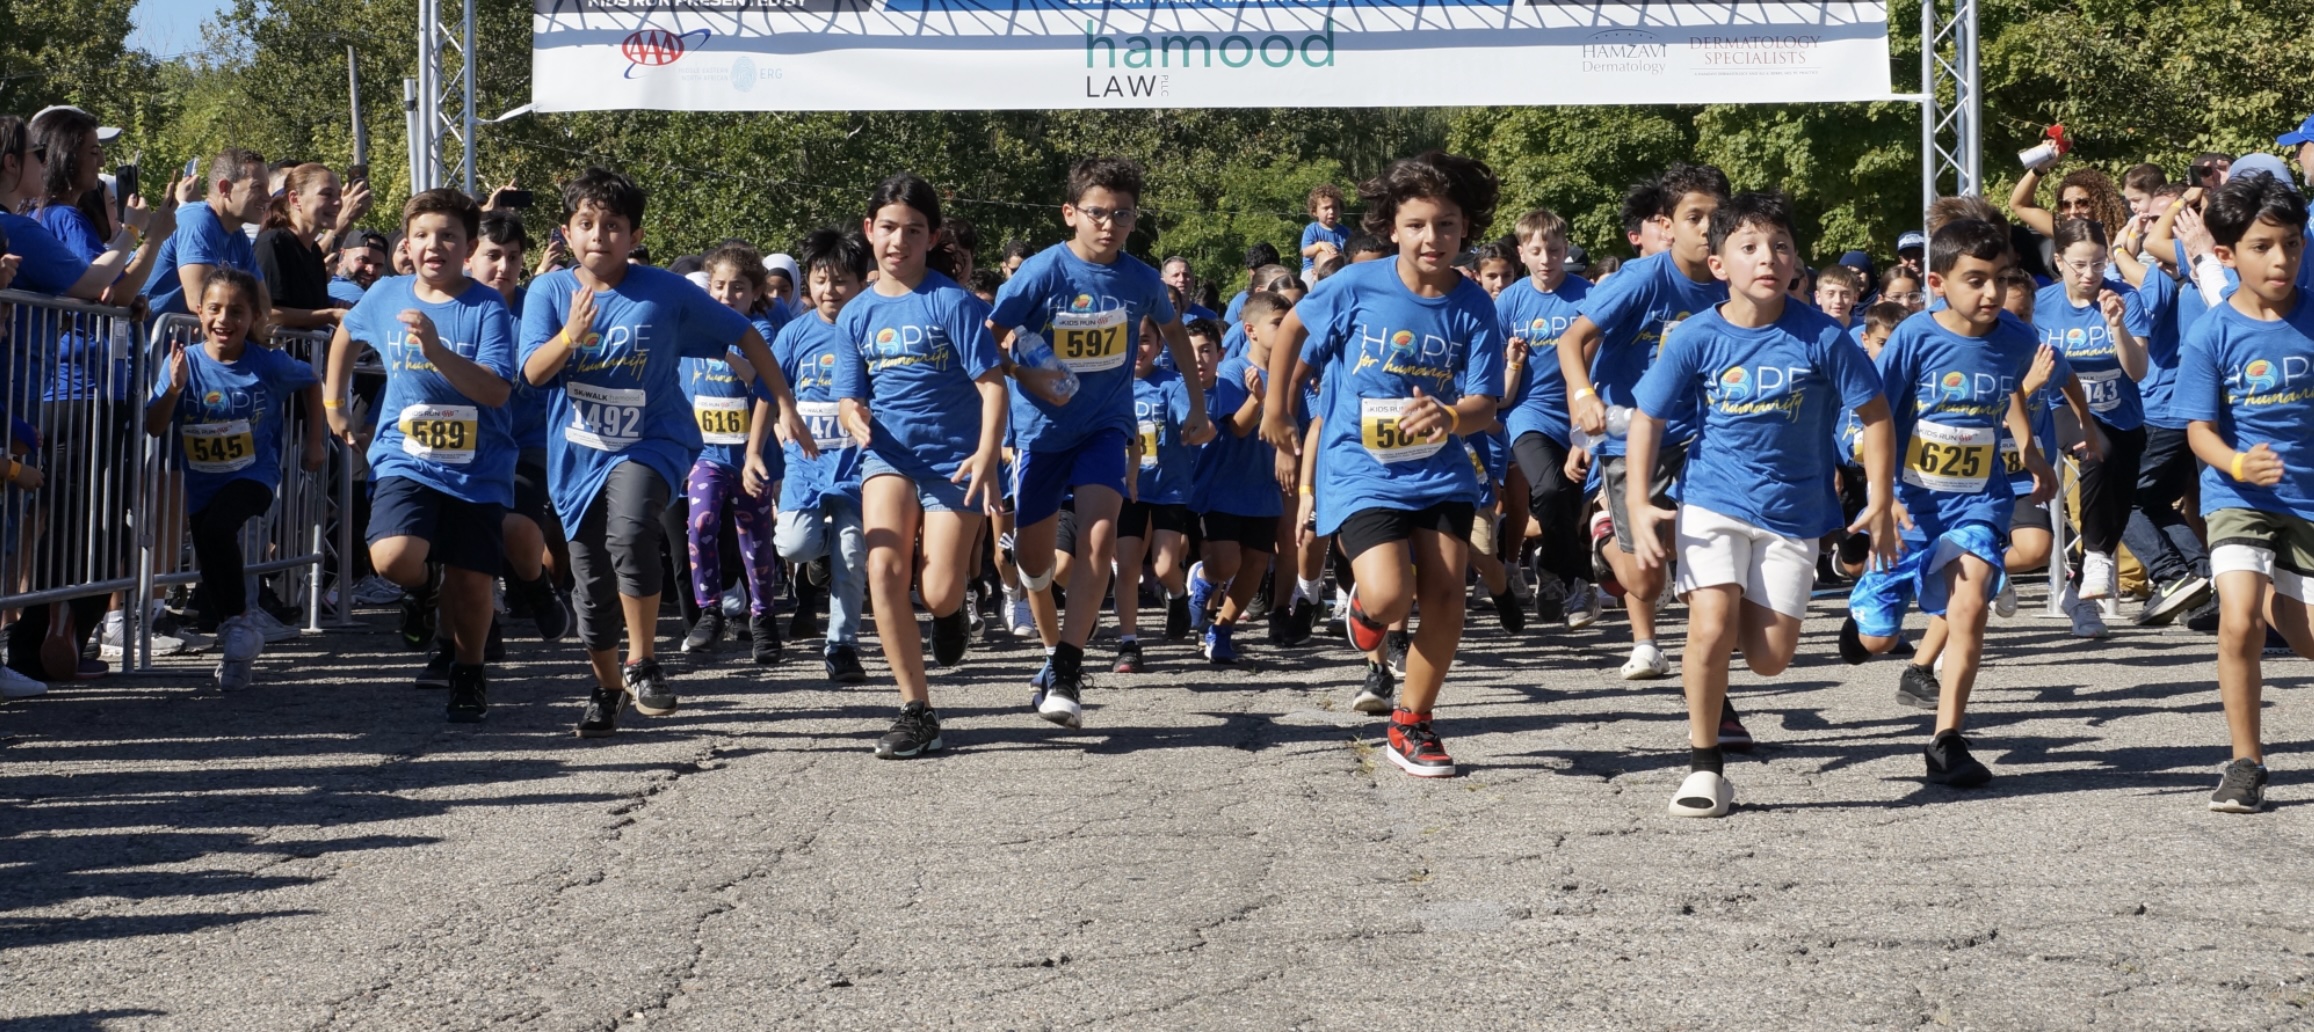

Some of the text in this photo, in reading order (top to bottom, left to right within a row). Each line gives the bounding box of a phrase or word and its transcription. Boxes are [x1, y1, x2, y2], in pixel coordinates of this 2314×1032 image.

[626, 30, 681, 65] AAA
[1086, 17, 1335, 68] hamood
[1583, 44, 1666, 59] HAMZAVI
[1690, 35, 1821, 50] DERMATOLOGY
[1582, 61, 1667, 75] Dermatology
[1704, 51, 1807, 65] SPECIALISTS
[760, 68, 783, 80] ERG
[1086, 75, 1157, 97] LAW
[1160, 74, 1169, 97] PLLC
[1066, 327, 1118, 358] 597
[1361, 323, 1463, 368] HOPE
[1352, 349, 1380, 376] for
[571, 399, 640, 438] 1492
[701, 410, 740, 433] 616
[411, 420, 465, 449] 589
[193, 436, 243, 462] 545
[1919, 442, 1983, 477] 625
